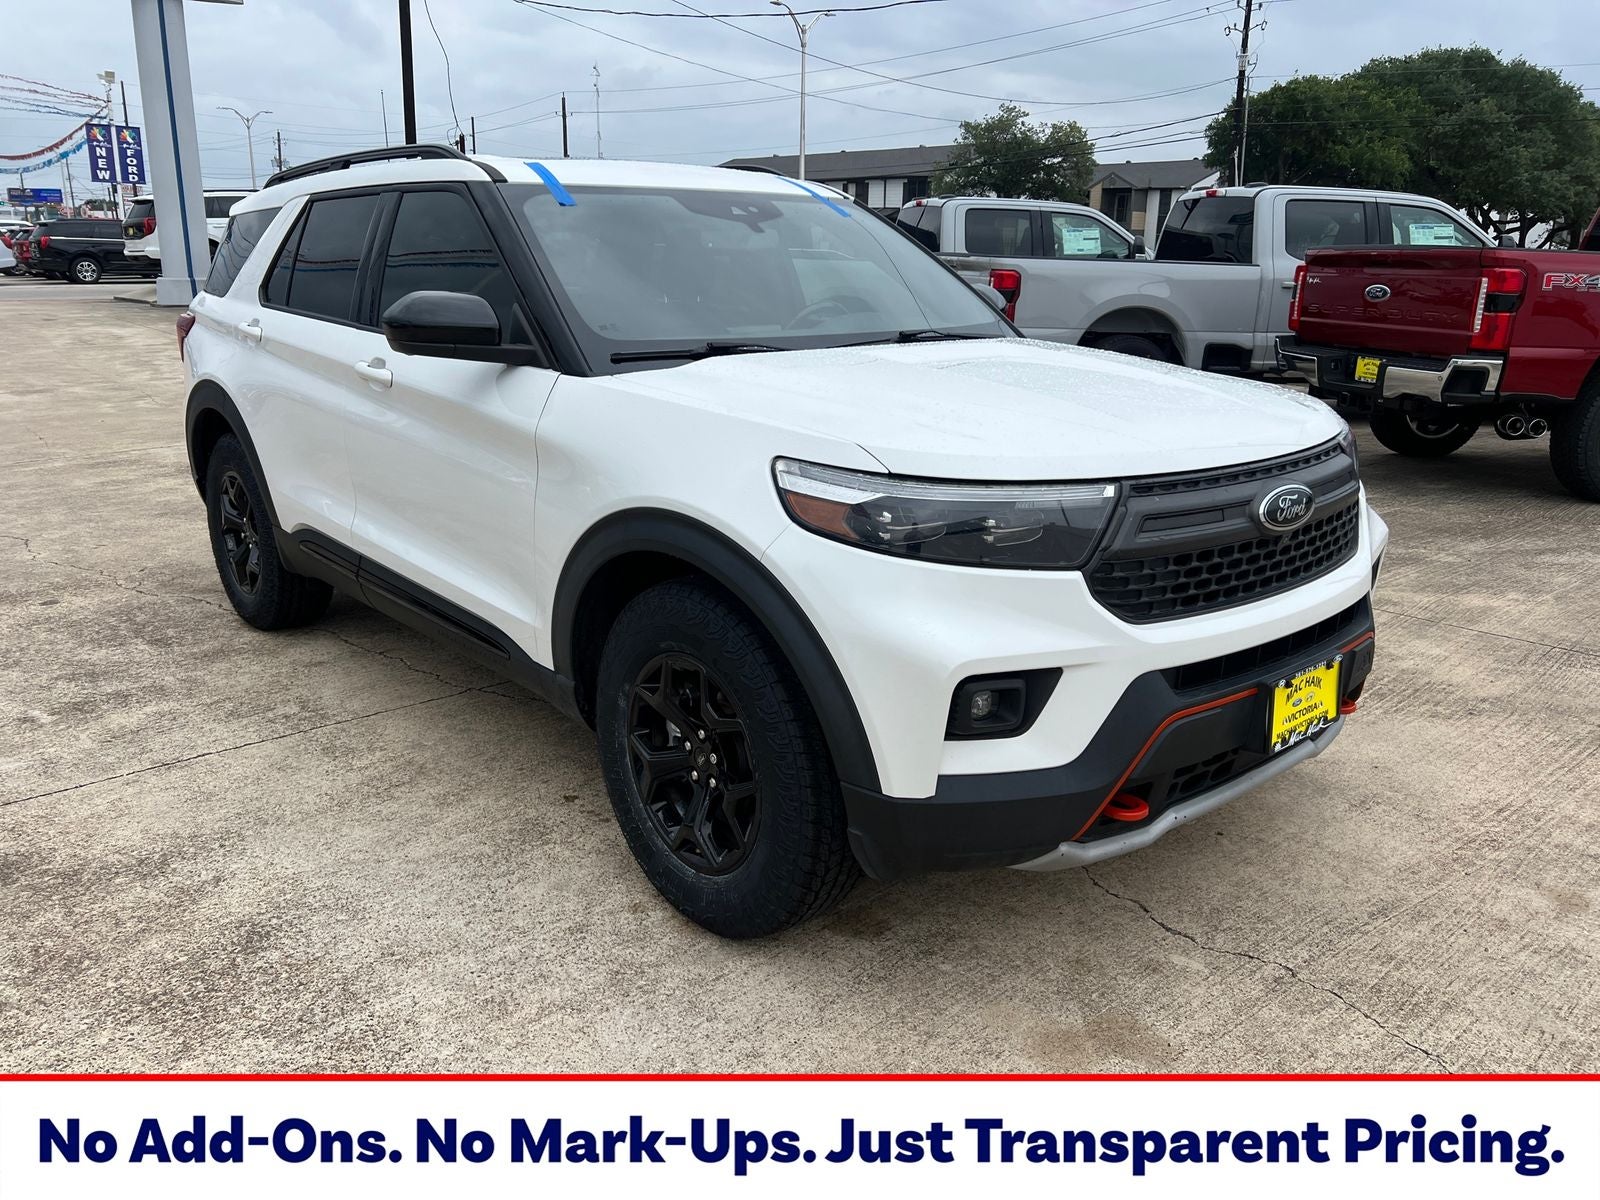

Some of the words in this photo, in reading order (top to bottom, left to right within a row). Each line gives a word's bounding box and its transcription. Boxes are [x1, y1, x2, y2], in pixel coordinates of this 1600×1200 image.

[95, 146, 110, 180] NEW
[126, 149, 139, 182] FORD
[1308, 304, 1381, 317] SUPER
[1386, 308, 1460, 323] DUTY
[1277, 494, 1307, 521] Ford
[1285, 680, 1304, 705] MAC
[1304, 676, 1323, 690] HAIK
[1286, 702, 1318, 723] VICTORIA
